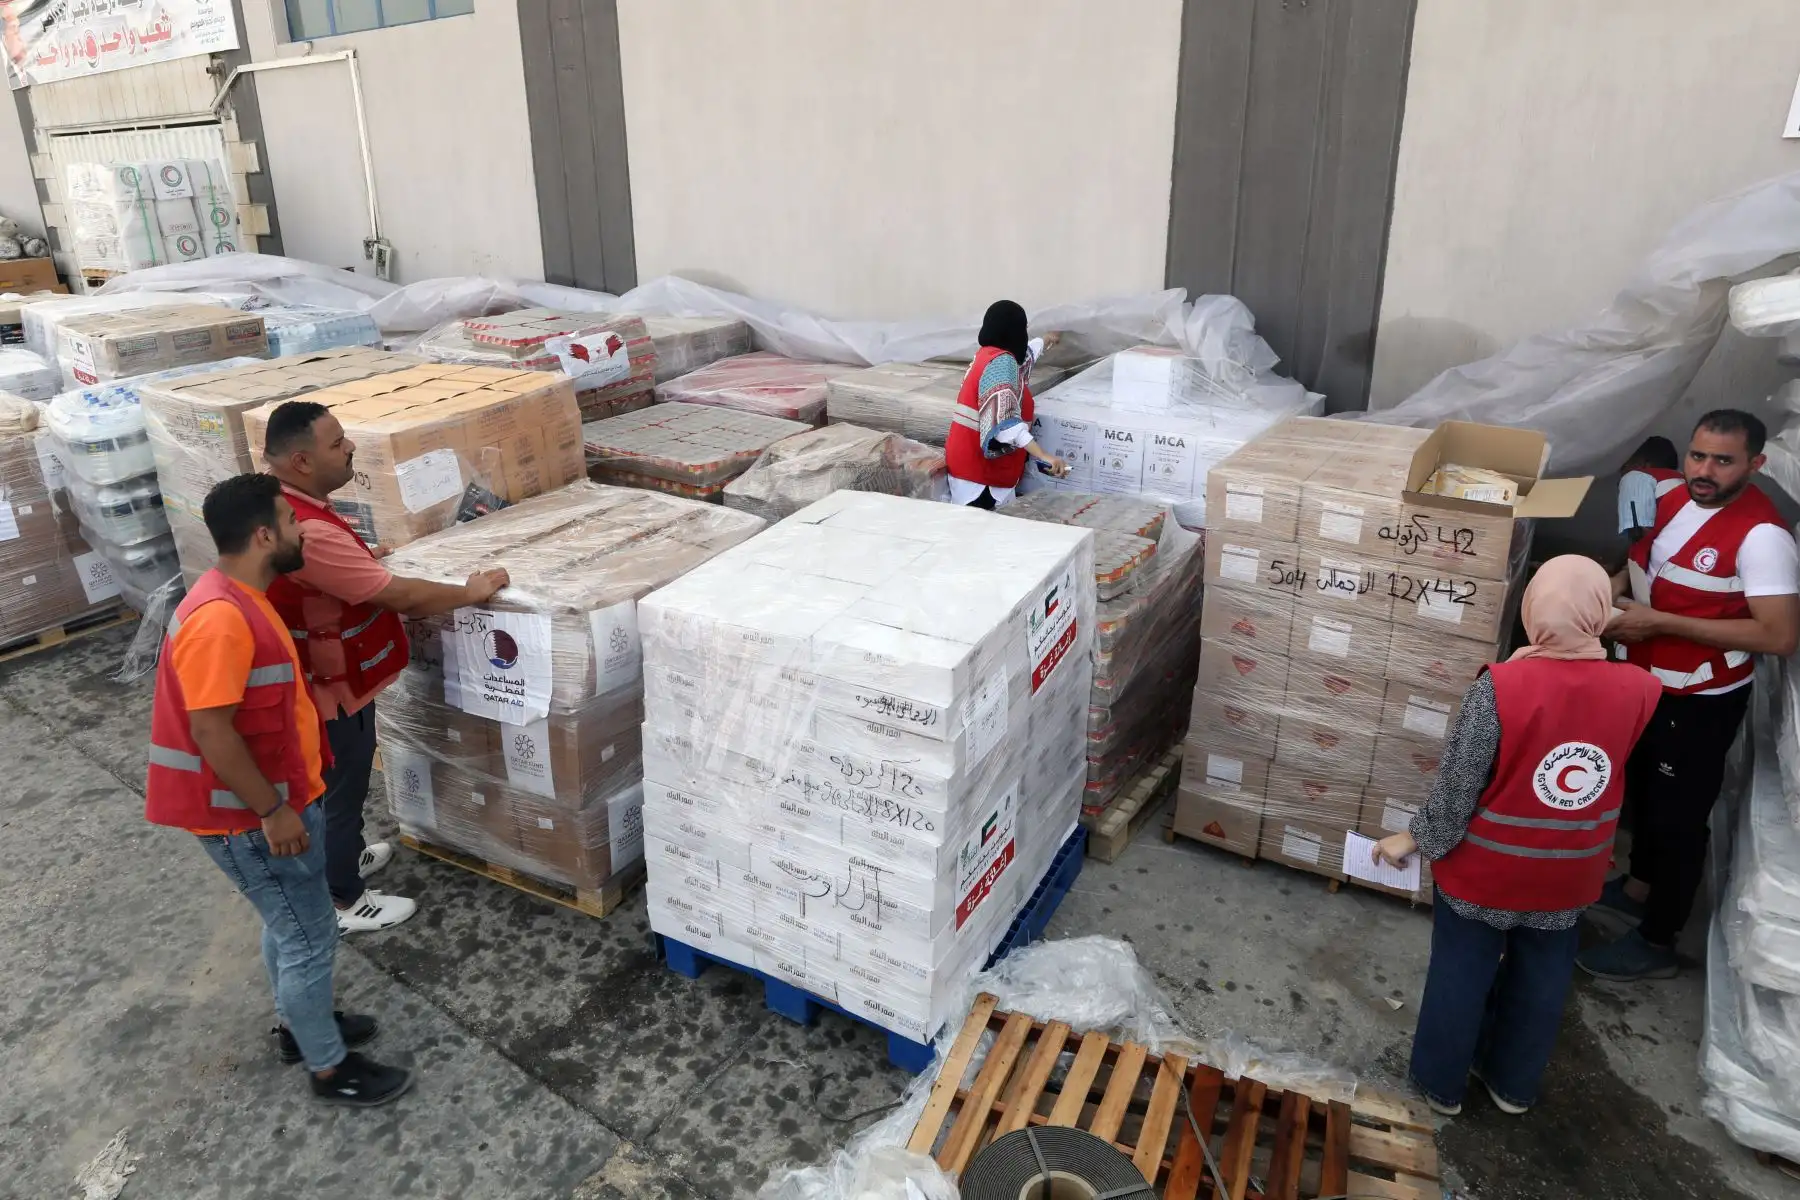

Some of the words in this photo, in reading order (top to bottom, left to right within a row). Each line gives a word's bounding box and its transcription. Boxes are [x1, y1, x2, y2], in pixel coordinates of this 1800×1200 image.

[1104, 429, 1133, 443] MCA
[1154, 434, 1185, 449] MCA
[1437, 526, 1477, 556] 42
[1269, 560, 1306, 590] 504
[483, 673, 525, 687] المساعدات
[484, 683, 525, 696] القطرية
[483, 693, 509, 704] QATAR
[511, 698, 524, 707] AID
[1537, 772, 1558, 804] EGYPTIAN
[1559, 798, 1574, 808] RED
[1577, 775, 1607, 806] CRESCENT
